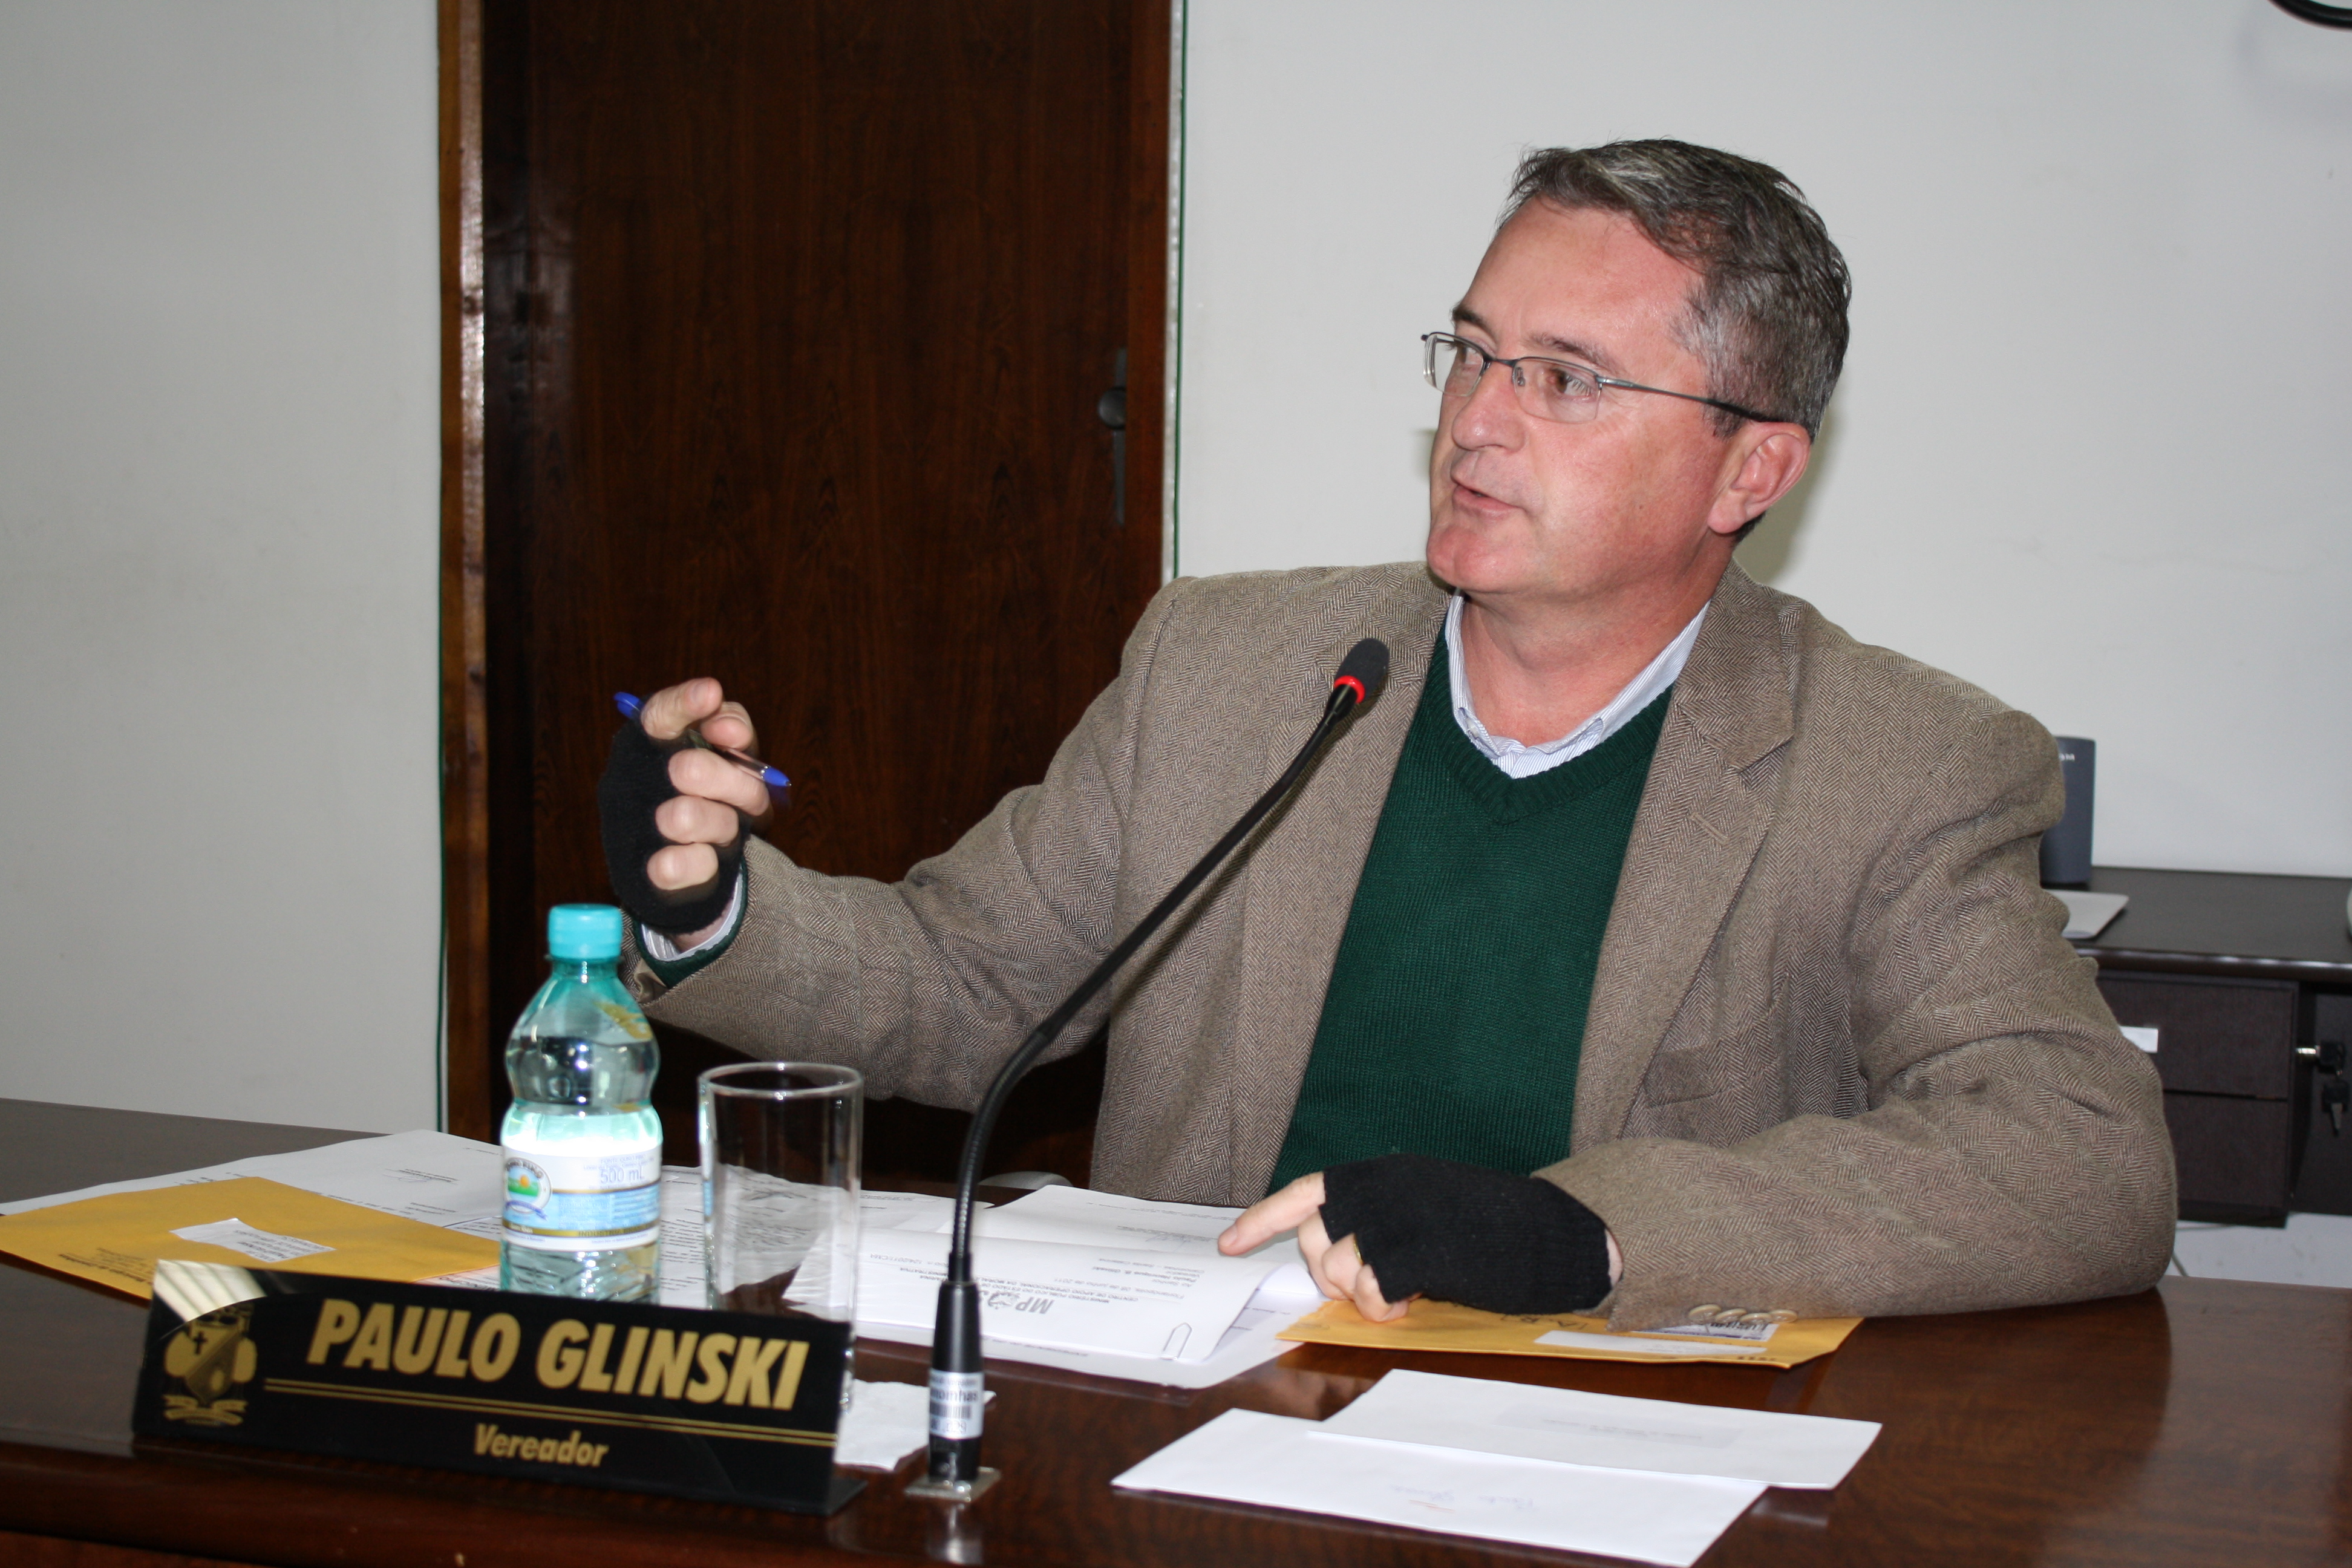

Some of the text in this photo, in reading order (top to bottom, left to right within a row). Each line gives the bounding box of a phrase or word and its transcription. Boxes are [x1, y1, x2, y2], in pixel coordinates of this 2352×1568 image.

[600, 1167, 625, 1184] 500
[307, 1298, 809, 1411] PAULO GLINSKI
[473, 1423, 608, 1468] Vereador
